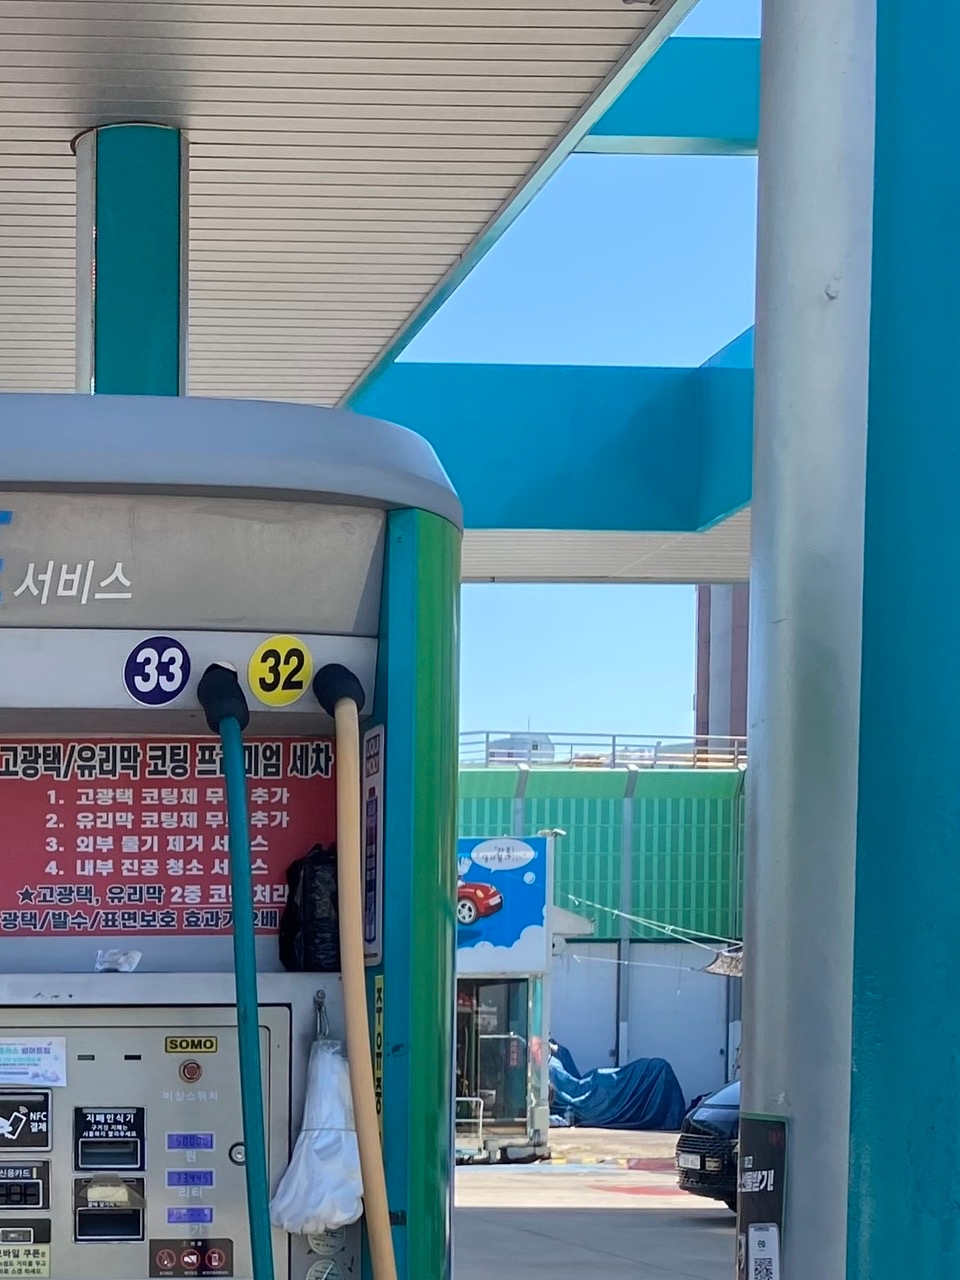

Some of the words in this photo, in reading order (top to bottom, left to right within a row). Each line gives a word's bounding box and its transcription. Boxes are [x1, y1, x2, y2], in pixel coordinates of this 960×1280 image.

[13, 559, 133, 605] 서비스
[134, 647, 185, 693] 33
[258, 648, 305, 693] 32
[146, 743, 190, 780] 코팅
[195, 742, 283, 779] 프미엄
[288, 741, 334, 778] 세차
[47, 789, 64, 804] 1.
[76, 788, 133, 805] 고광택
[141, 787, 198, 805] 코팅제
[250, 787, 289, 804] 추가
[45, 813, 64, 828] 2.
[76, 812, 134, 829] 유리막
[141, 812, 198, 829] 코팅제
[250, 811, 289, 828] 추가
[45, 837, 64, 851] 3.
[76, 836, 114, 853] 외부
[121, 836, 158, 853] 물기
[166, 835, 203, 852] 제거
[211, 835, 268, 852] 서스
[45, 861, 64, 875] 4.
[76, 859, 114, 876] 내부
[121, 859, 159, 876] 진공
[166, 858, 204, 876] 청소
[211, 858, 269, 876] 서스
[107, 884, 165, 904] 유리막
[170, 885, 202, 903] 2중
[253, 884, 289, 903] 처리
[169, 1039, 214, 1050] SOMO
[162, 1091, 218, 1102] 비상스위치
[30, 1112, 47, 1121] NFC
[86, 1113, 134, 1123] 지폐인식기
[30, 1122, 47, 1133] 결제
[0, 1169, 31, 1178] 신용카드
[178, 1187, 203, 1199] 리터
